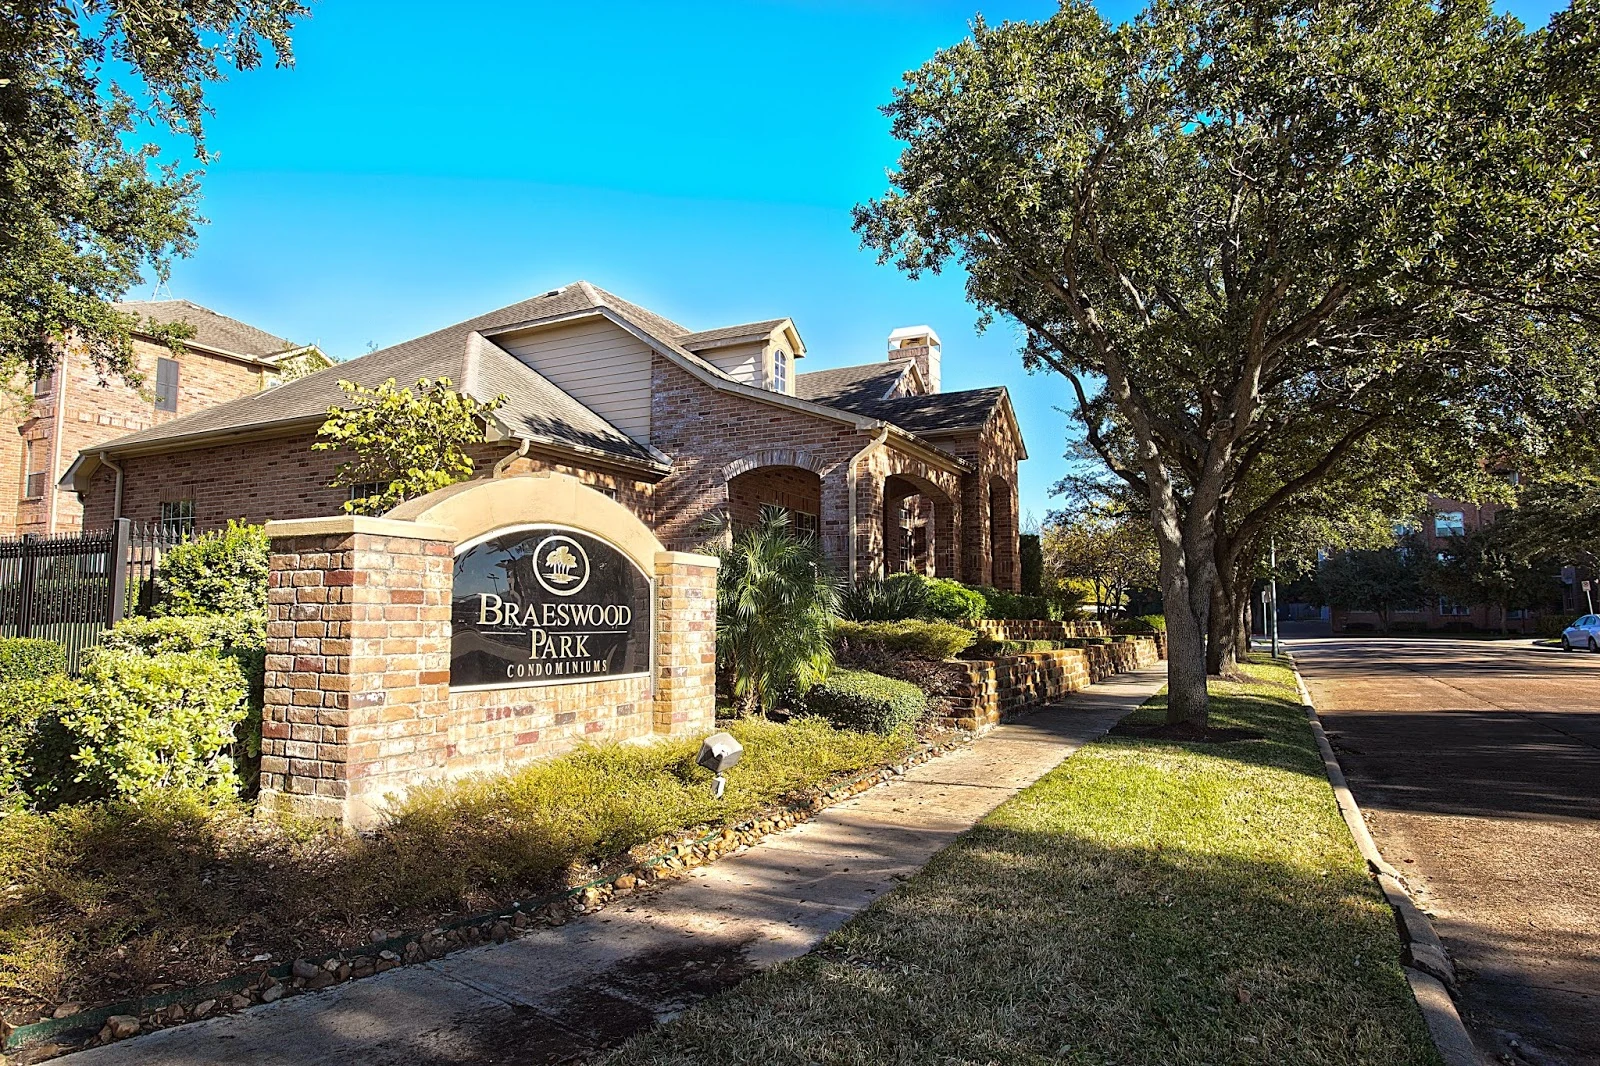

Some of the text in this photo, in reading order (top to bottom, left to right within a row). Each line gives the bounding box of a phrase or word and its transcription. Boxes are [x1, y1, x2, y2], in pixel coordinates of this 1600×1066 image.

[476, 592, 631, 627] BRAESWOOD
[529, 628, 591, 660] PARK
[506, 659, 608, 678] CONDOMINIUMS
